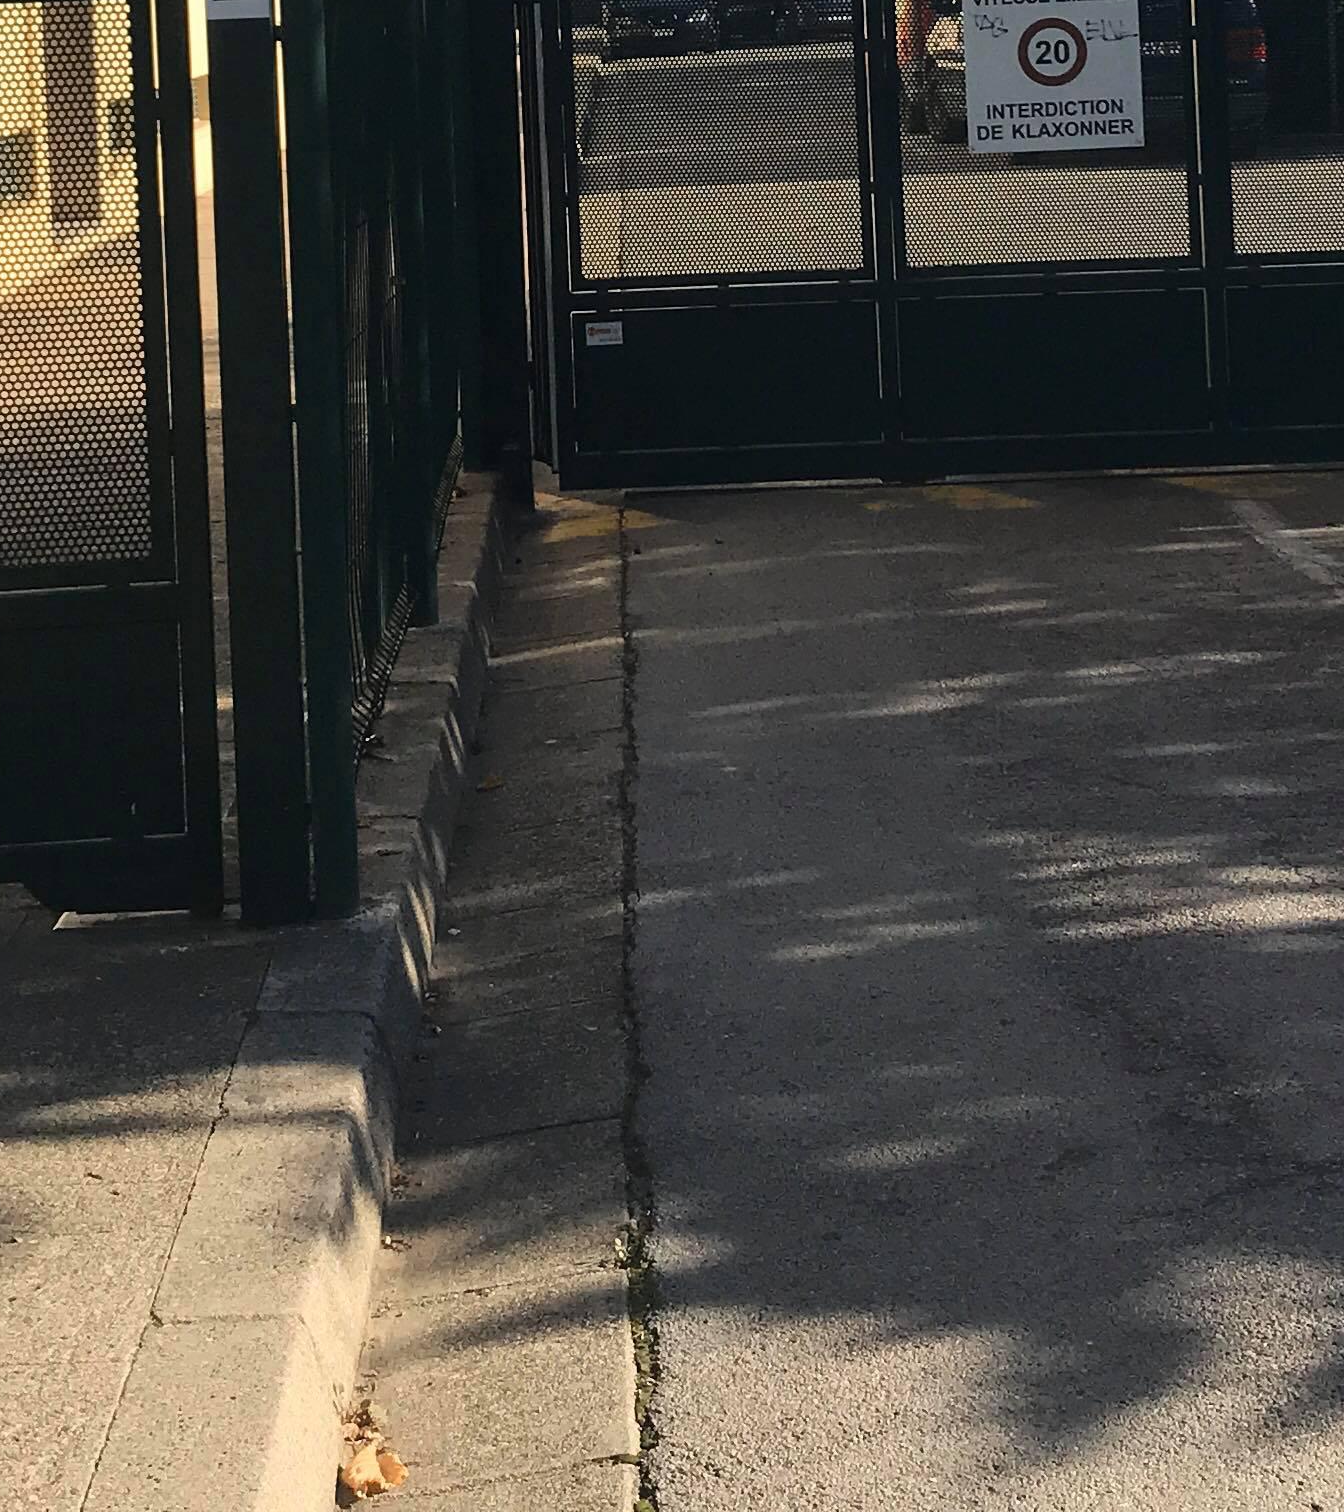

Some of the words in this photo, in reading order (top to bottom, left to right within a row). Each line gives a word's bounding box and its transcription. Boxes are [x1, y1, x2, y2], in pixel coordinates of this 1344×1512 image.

[1035, 40, 1070, 65] 20
[986, 99, 1124, 120] INTERDICTION
[976, 125, 1004, 141] DE
[1012, 119, 1135, 140] KLAXONNER
